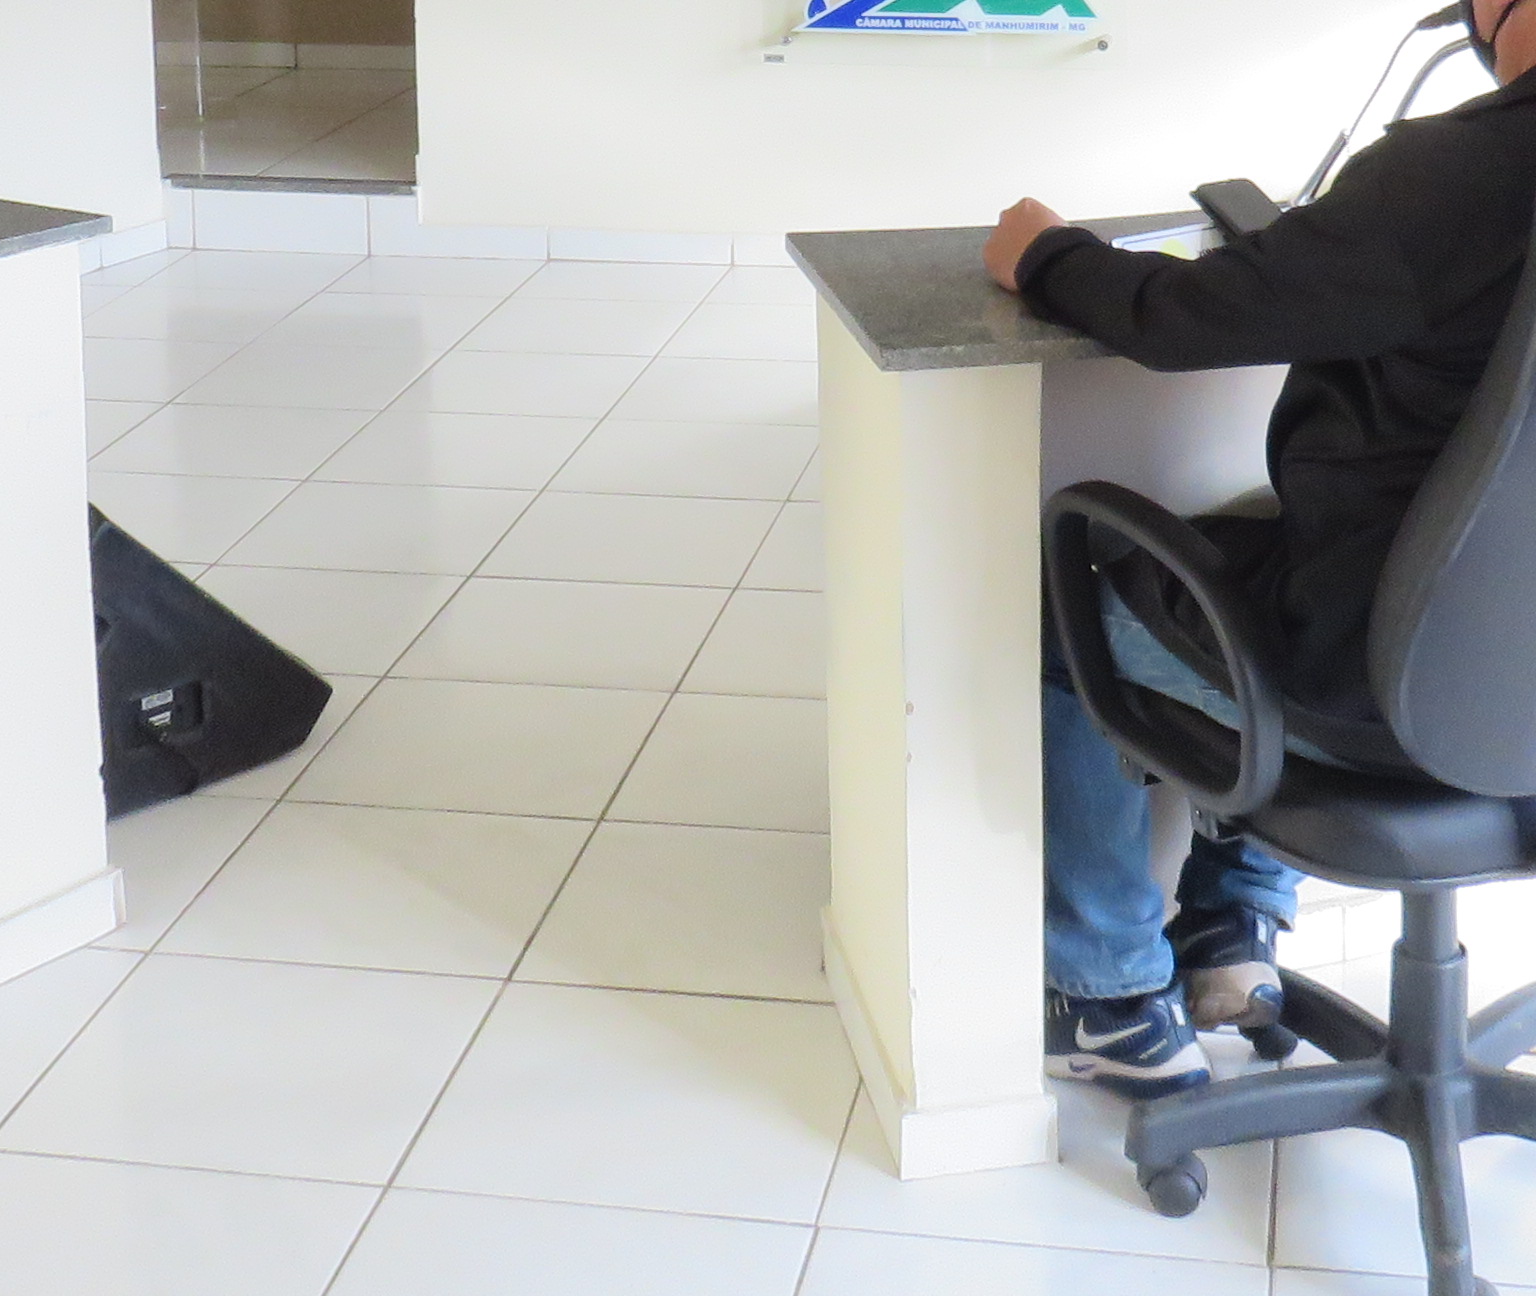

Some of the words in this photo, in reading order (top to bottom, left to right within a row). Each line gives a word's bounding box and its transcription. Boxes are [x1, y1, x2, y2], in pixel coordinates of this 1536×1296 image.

[855, 16, 902, 28] CÂMARA
[904, 18, 964, 29] MUNICIPAL
[967, 20, 982, 29] DE
[984, 21, 1059, 31] MANHUMIRIM
[1068, 22, 1086, 31] MG
